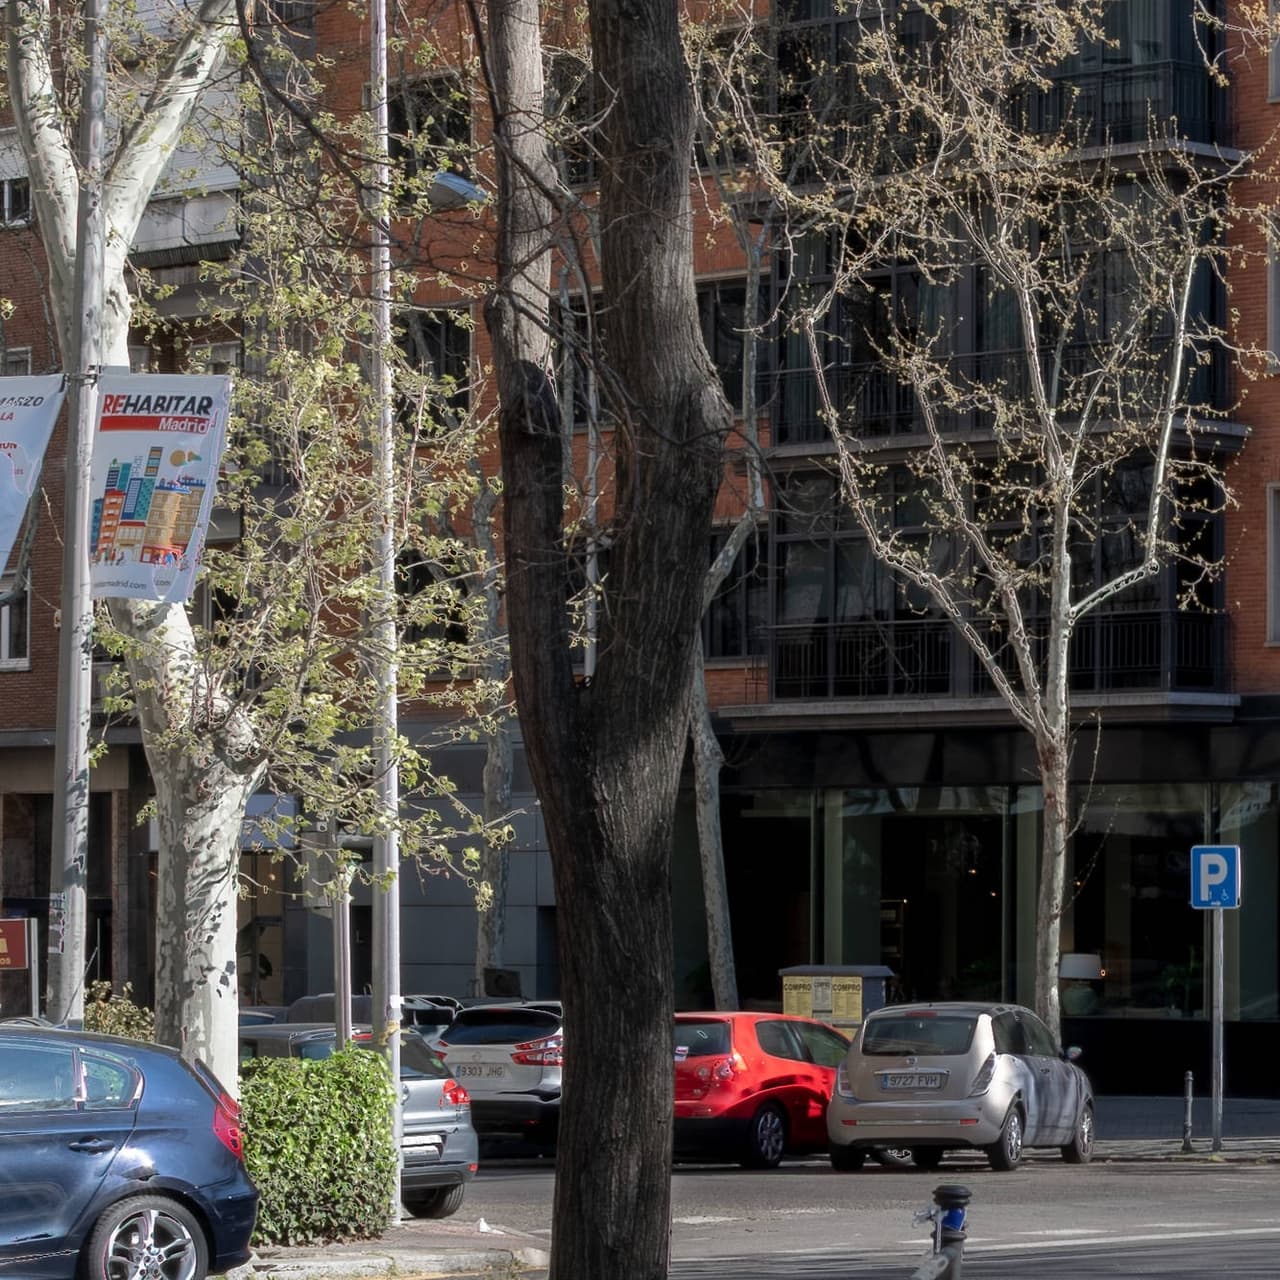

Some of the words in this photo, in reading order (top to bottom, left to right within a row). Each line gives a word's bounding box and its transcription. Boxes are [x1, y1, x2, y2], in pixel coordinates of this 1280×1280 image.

[102, 394, 213, 416] REHABITAR
[159, 417, 208, 433] Madrid
[1200, 853, 1228, 901] P
[784, 983, 812, 991] COMPRO
[832, 983, 861, 991] COMPRO
[890, 1075, 913, 1086] 9727
[918, 1075, 937, 1086] FVH
